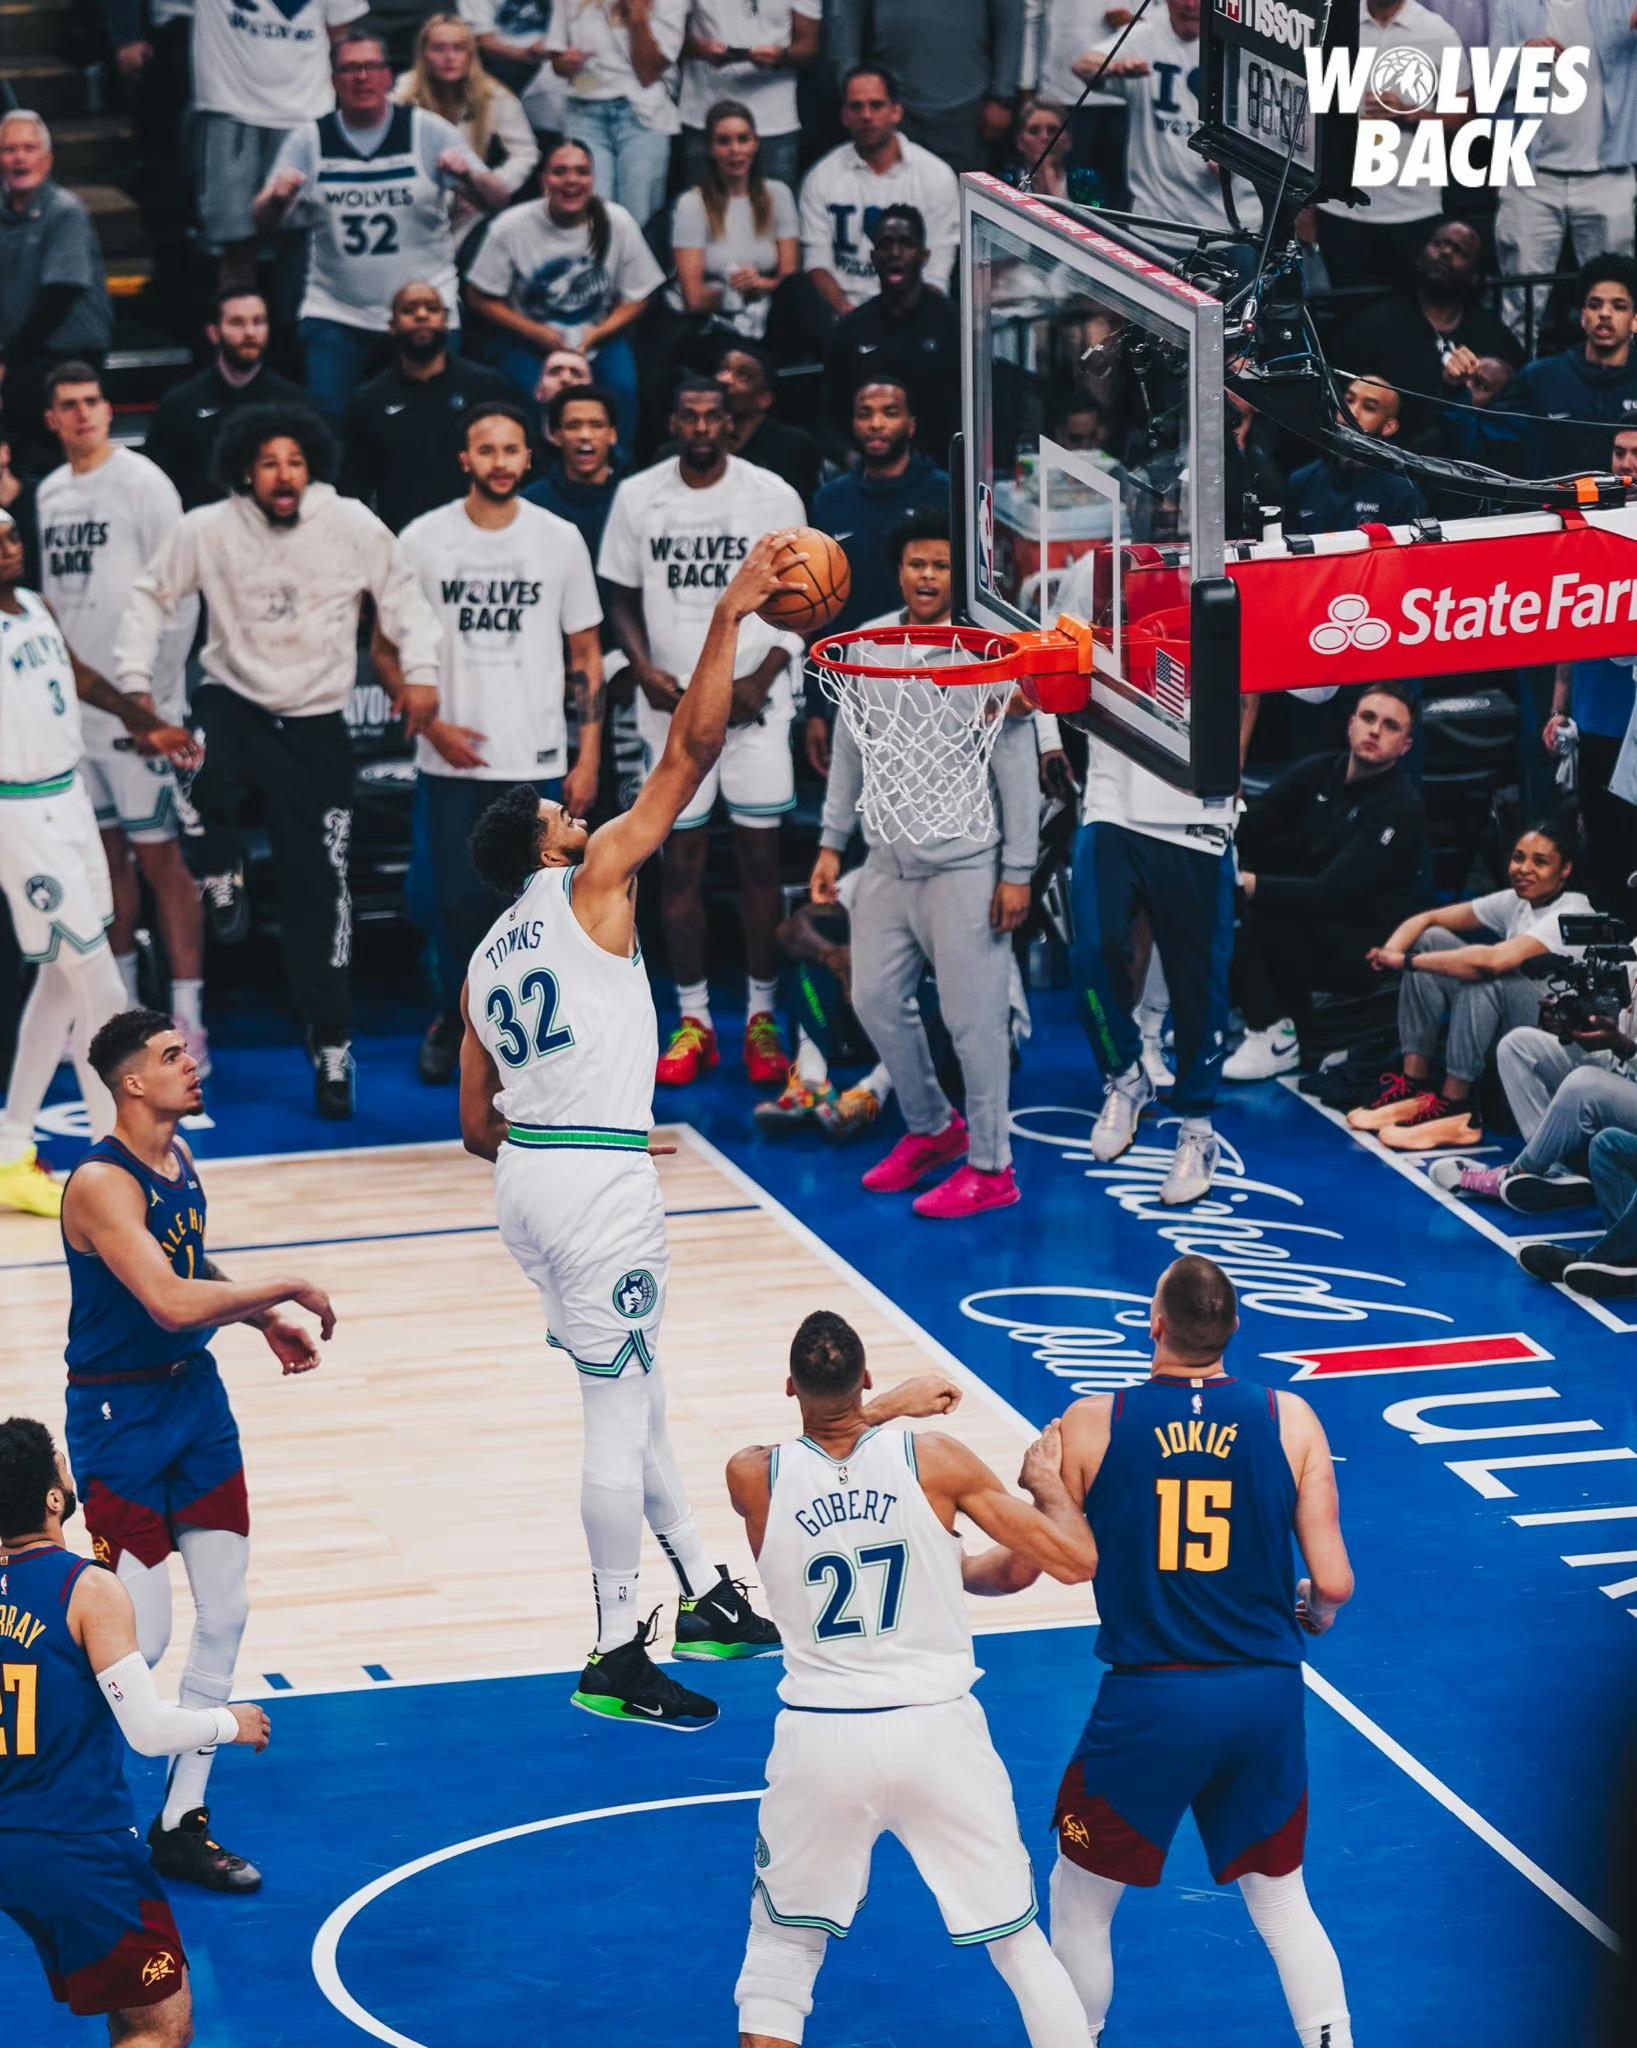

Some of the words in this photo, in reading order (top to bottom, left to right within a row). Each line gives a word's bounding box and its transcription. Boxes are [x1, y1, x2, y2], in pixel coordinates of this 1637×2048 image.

[325, 187, 414, 207] WOLVES
[341, 213, 399, 257] 32
[51, 550, 94, 576] BACK
[650, 536, 748, 561] WOLVES
[441, 580, 542, 605] WOLVES
[667, 563, 730, 588] BACK
[459, 607, 523, 632] BACK
[1546, 573, 1637, 631] Far
[48, 679, 65, 715] 3
[485, 920, 545, 970] TOWNS
[485, 966, 576, 1068] 32
[161, 1212, 188, 1262] ILE
[1154, 1419, 1239, 1459] JOKIĆ
[795, 1489, 898, 1537] GOBERT
[1156, 1478, 1233, 1572] 15
[804, 1538, 910, 1643] 27
[0, 1662, 38, 1757] 7
